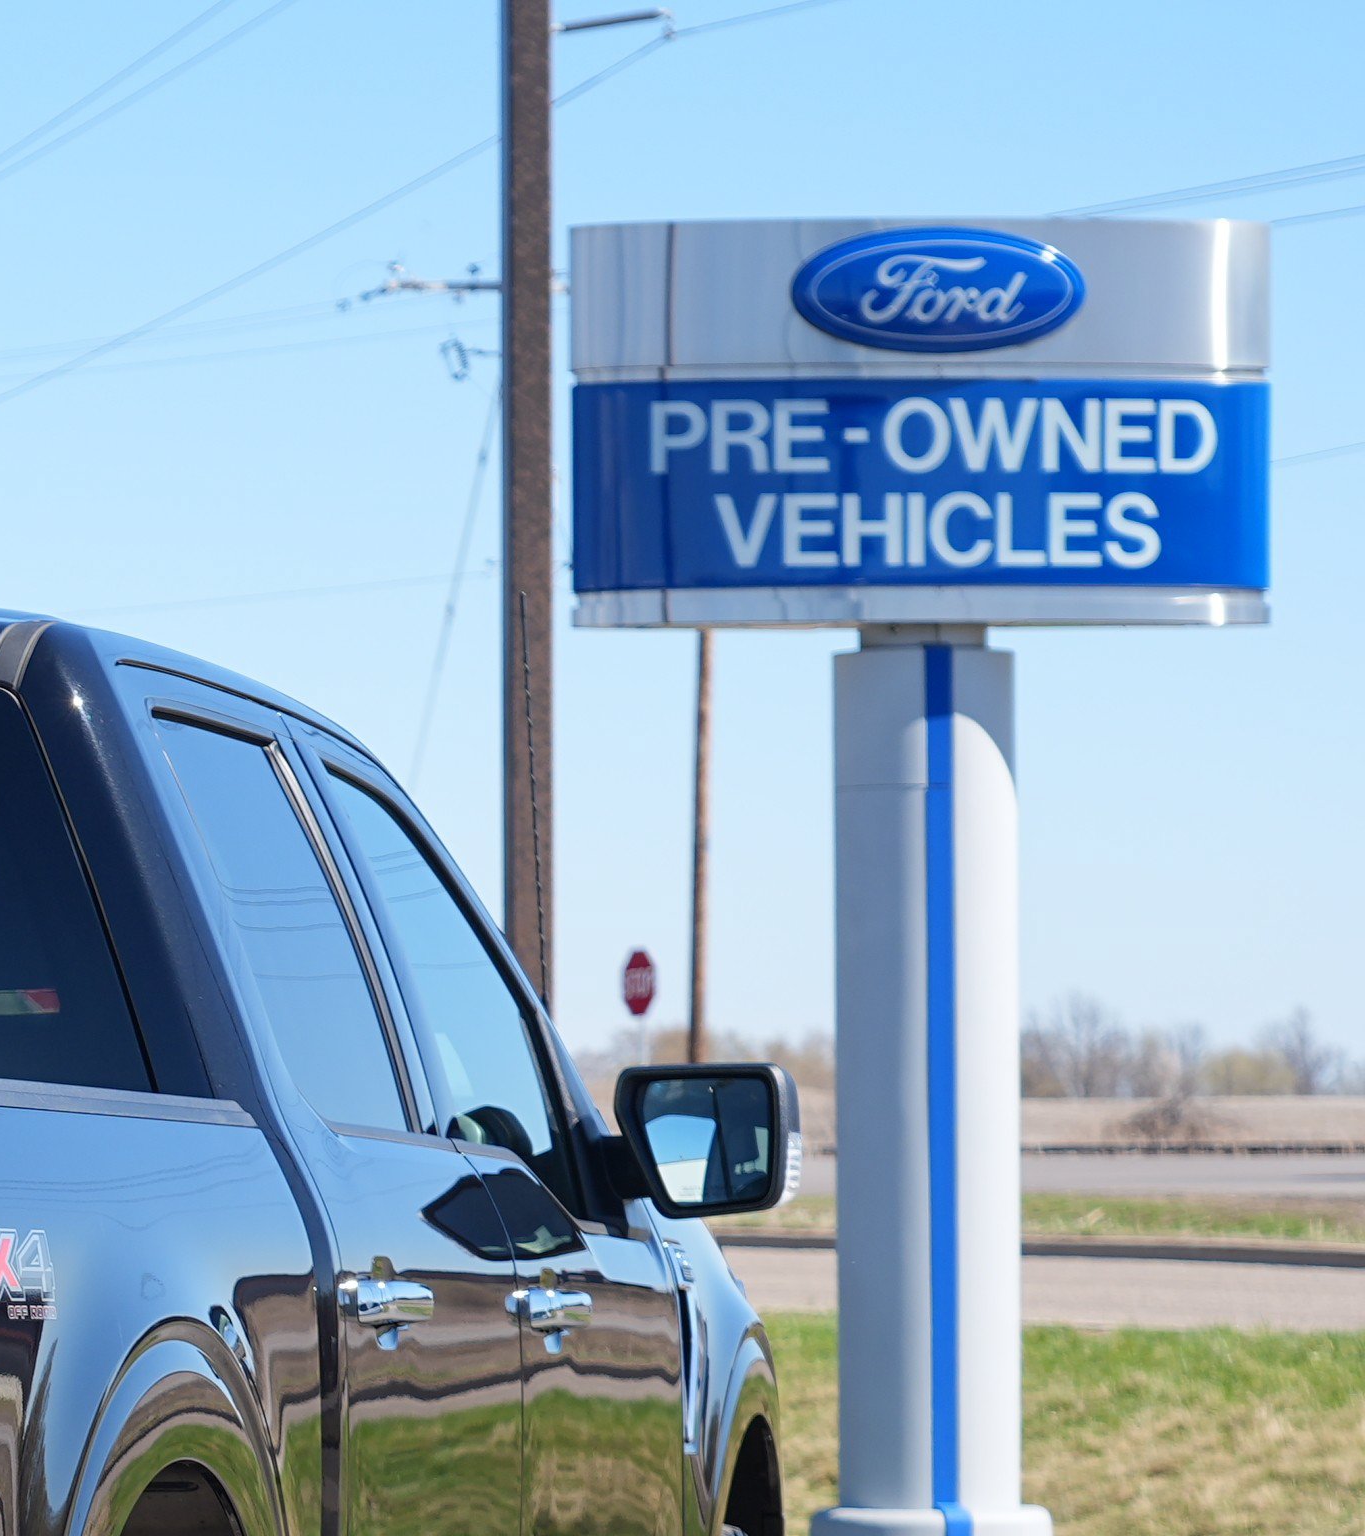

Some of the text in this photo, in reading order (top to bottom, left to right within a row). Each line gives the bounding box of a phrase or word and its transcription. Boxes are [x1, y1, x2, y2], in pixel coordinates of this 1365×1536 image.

[860, 254, 1027, 324] Ford
[715, 491, 1162, 568] VEHICLES
[8, 1305, 57, 1319] OFF ROAD
